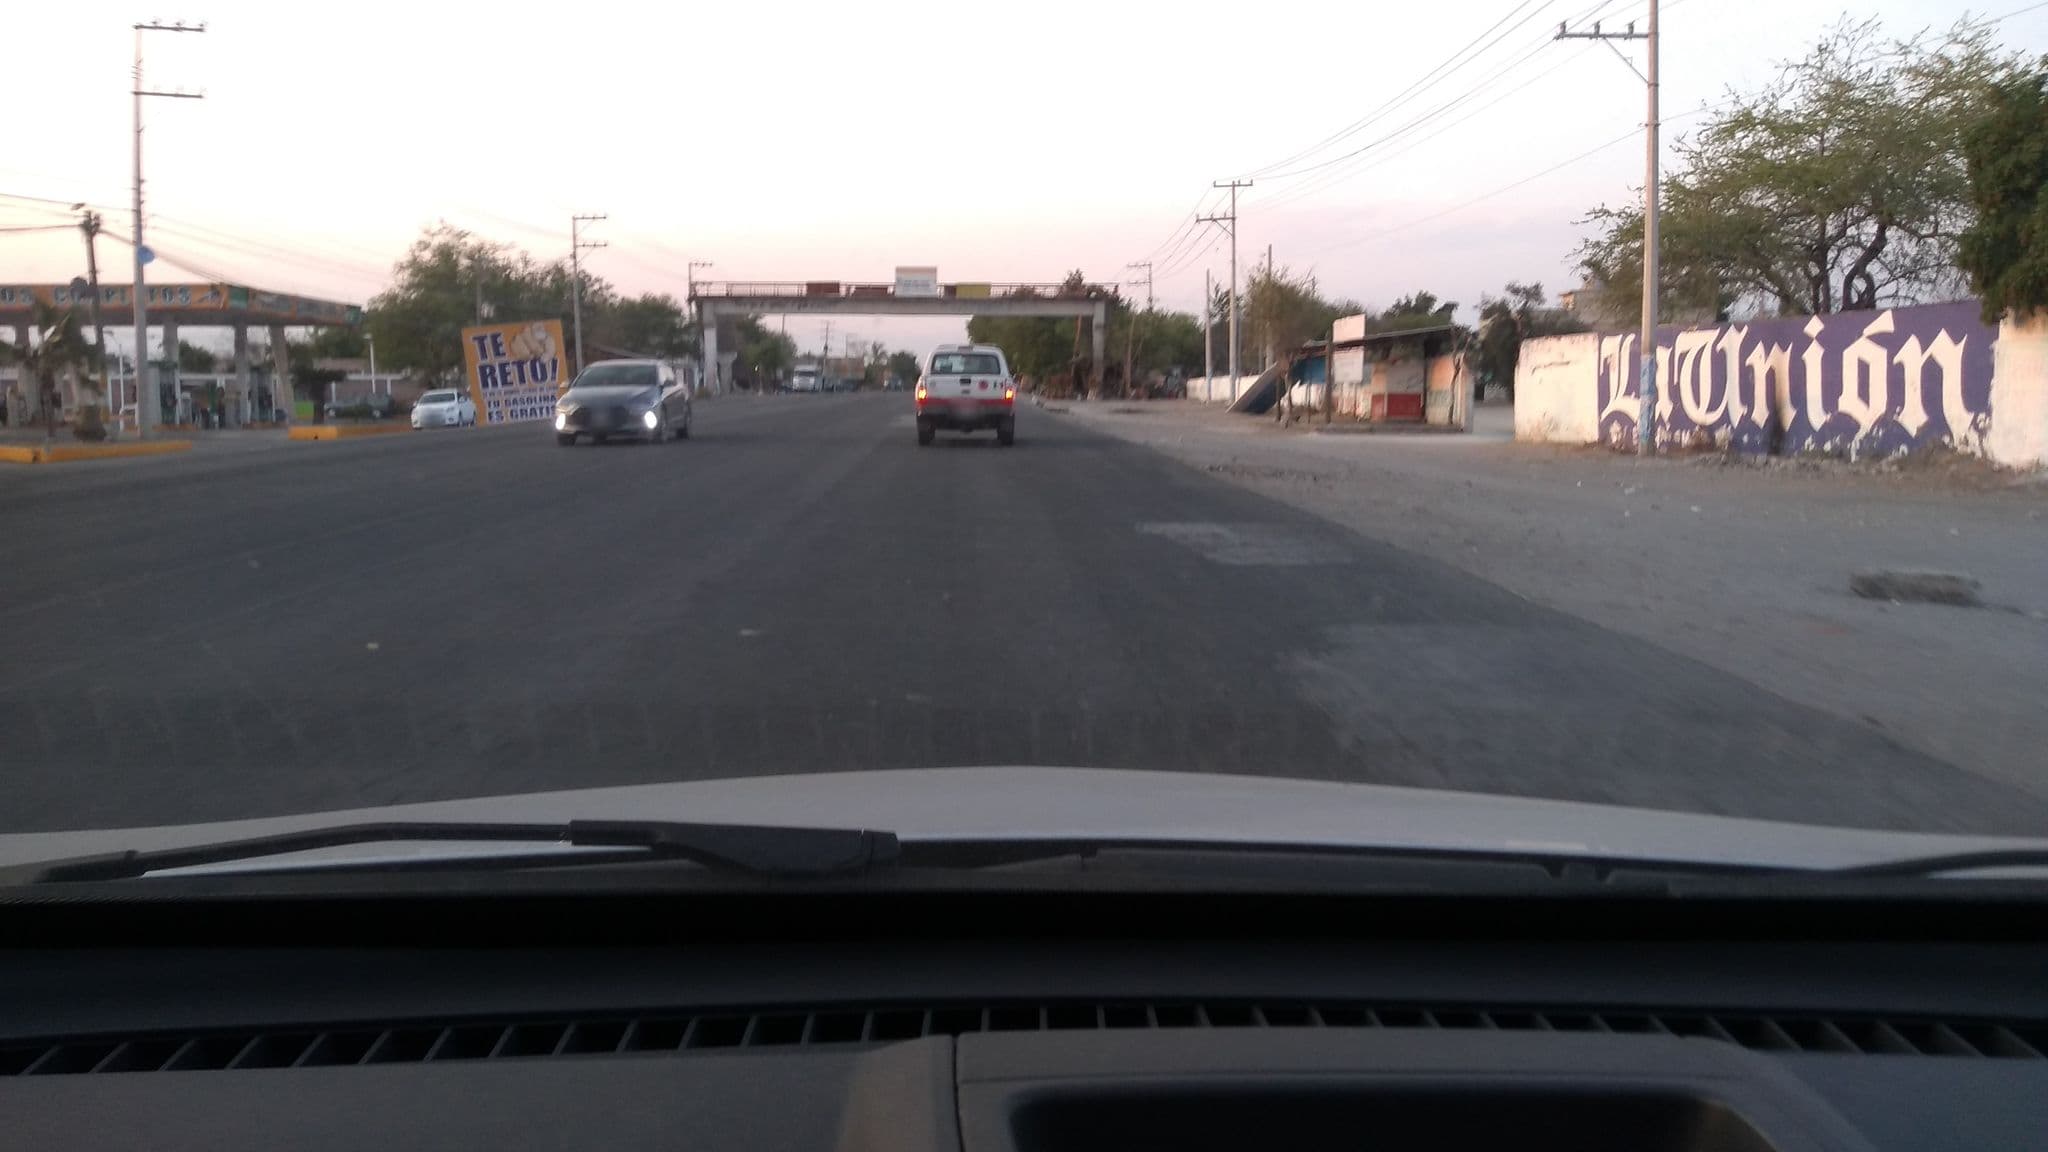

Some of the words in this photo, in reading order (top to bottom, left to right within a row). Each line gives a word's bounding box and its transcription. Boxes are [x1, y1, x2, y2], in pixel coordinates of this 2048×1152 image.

[472, 333, 506, 360] TE
[478, 356, 557, 388] RETO!
[1673, 310, 1977, 444] Unión
[504, 394, 557, 408] GASOLINA
[488, 410, 504, 422] ES
